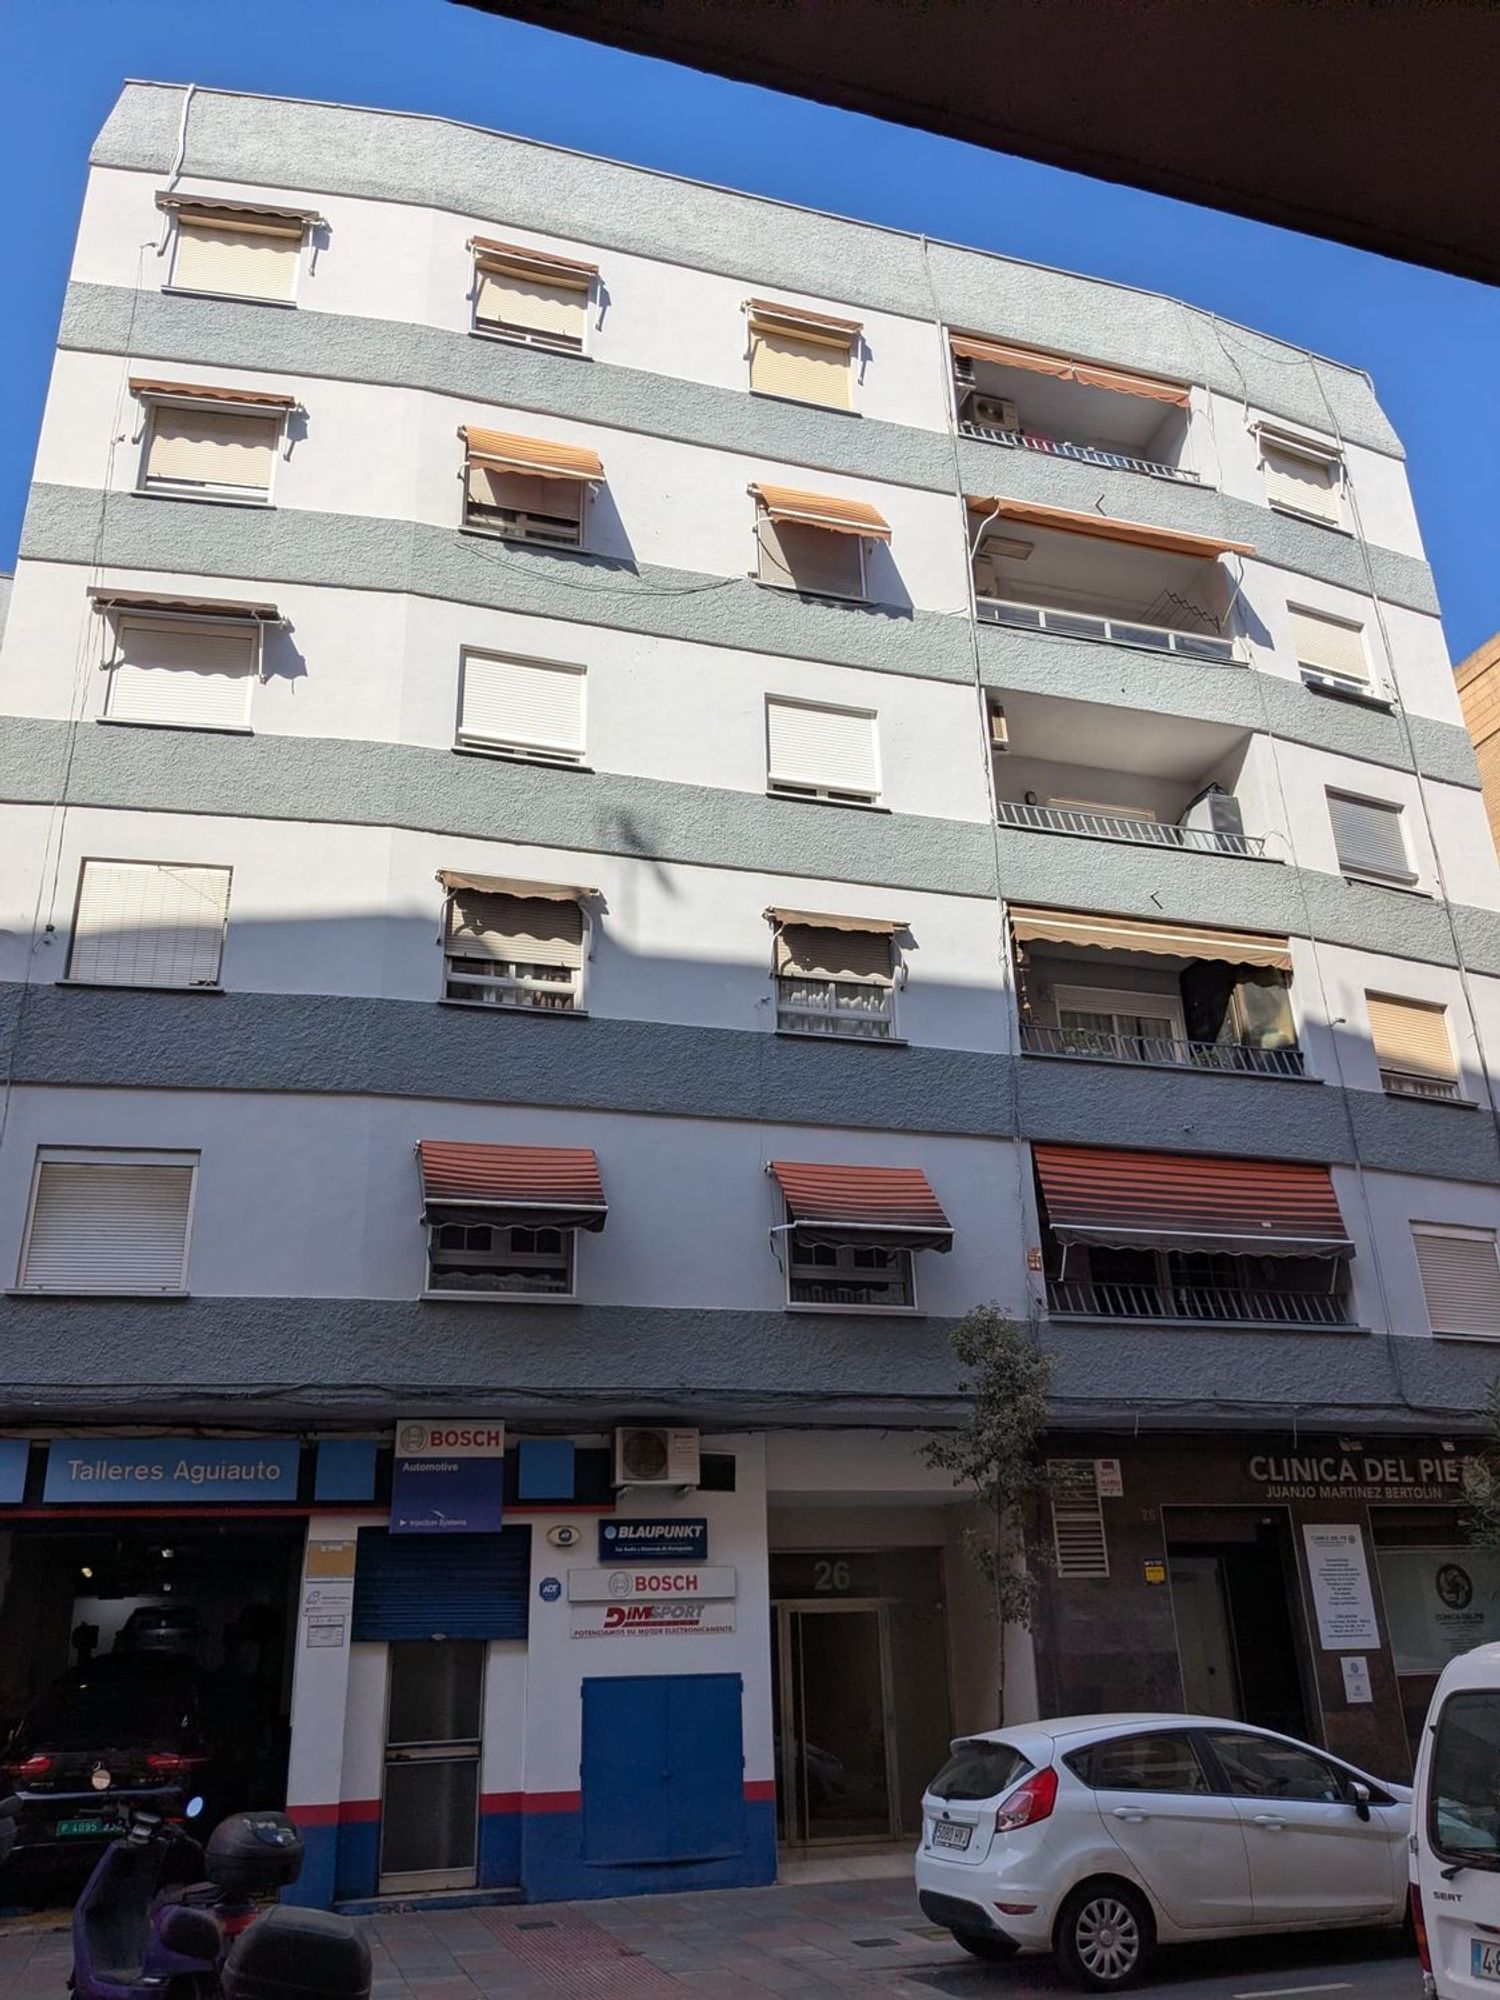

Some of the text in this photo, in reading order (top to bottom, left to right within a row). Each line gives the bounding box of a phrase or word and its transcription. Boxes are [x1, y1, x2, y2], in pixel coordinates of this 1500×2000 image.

[430, 1430, 500, 1447] BOSCH
[68, 1460, 280, 1485] Talleres Aguiauto
[401, 1462, 459, 1472] Automotive
[1249, 1455, 1460, 1483] CLINICA DEL PIE
[1266, 1485, 1316, 1499] JUANJO
[1319, 1485, 1382, 1499] MARTINEZ
[617, 1525, 704, 1539] BLAUPUNKT
[635, 1574, 698, 1592] BOSCH
[814, 1560, 850, 1591] 26
[1433, 1891, 1462, 1902] SEAT
